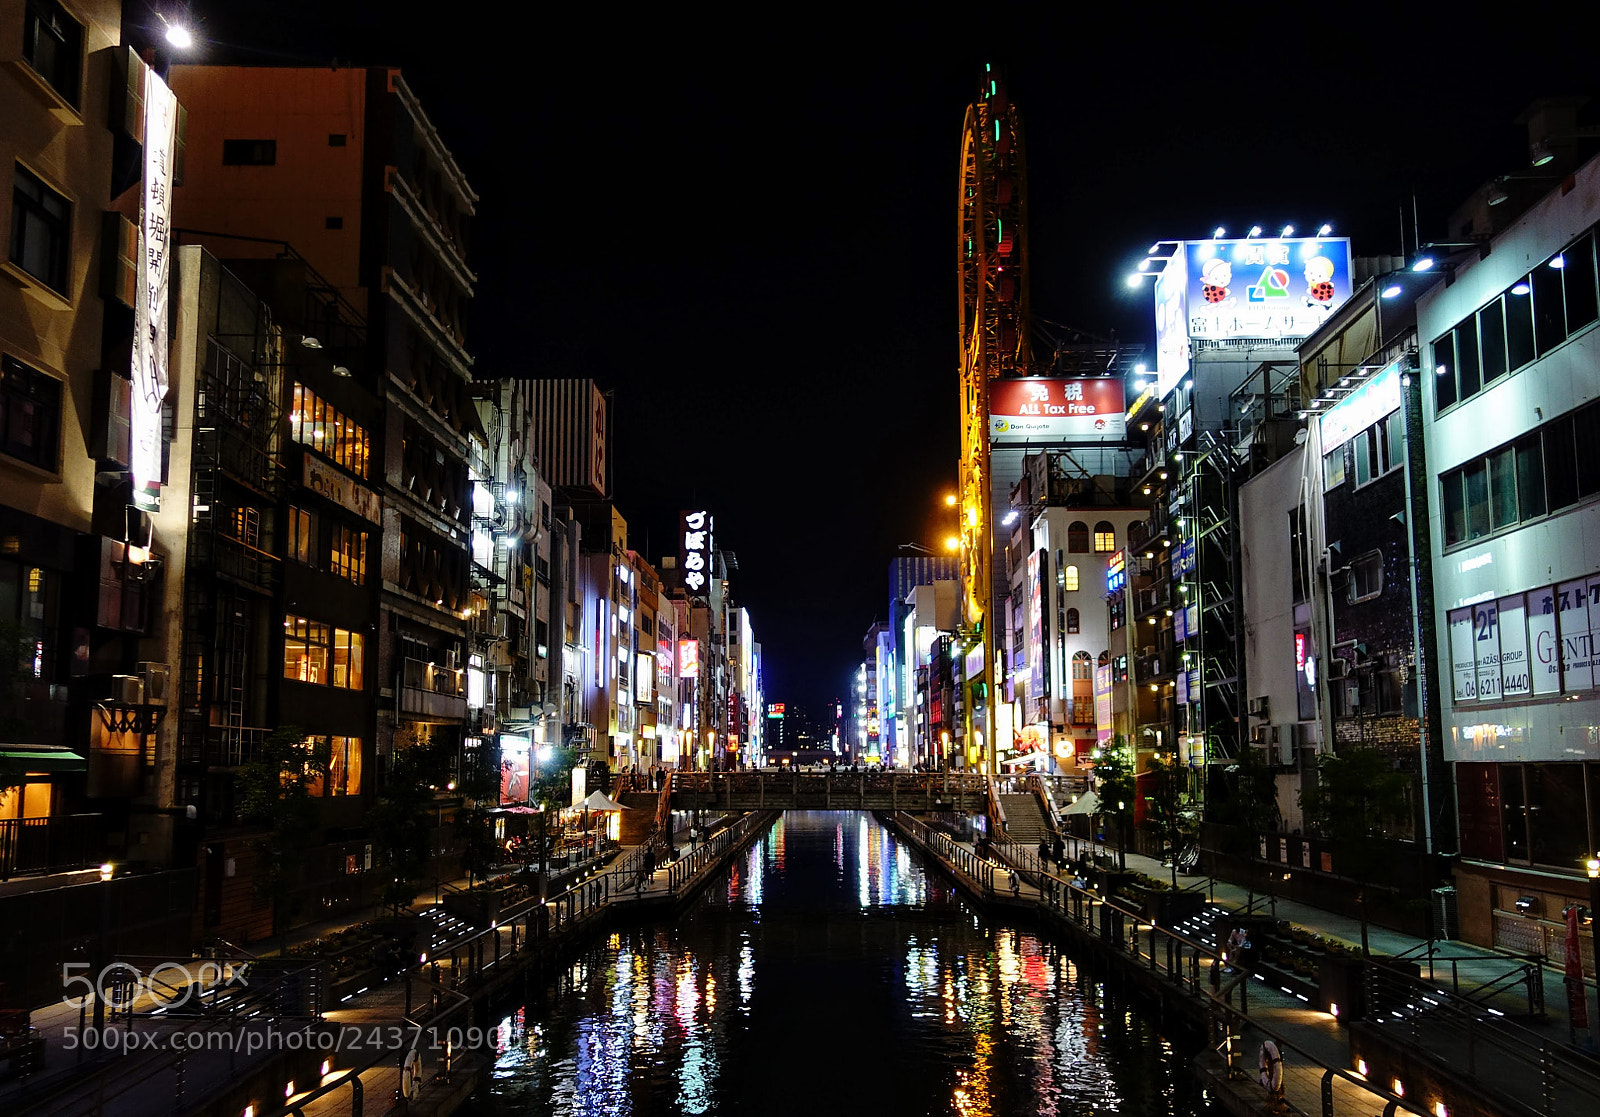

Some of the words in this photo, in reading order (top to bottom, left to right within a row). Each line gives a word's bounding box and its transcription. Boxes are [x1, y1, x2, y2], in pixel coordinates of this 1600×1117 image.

[1019, 403, 1041, 415] ALL
[1043, 403, 1066, 414] Tax
[1068, 403, 1096, 414] Free
[1026, 423, 1050, 431] Quijote
[685, 510, 708, 591] づぼらや
[1476, 608, 1497, 642] 2F
[1502, 650, 1523, 662] GROUP
[1465, 681, 1476, 697] 06
[1480, 677, 1501, 695] 6211
[1504, 673, 1529, 692] 4440
